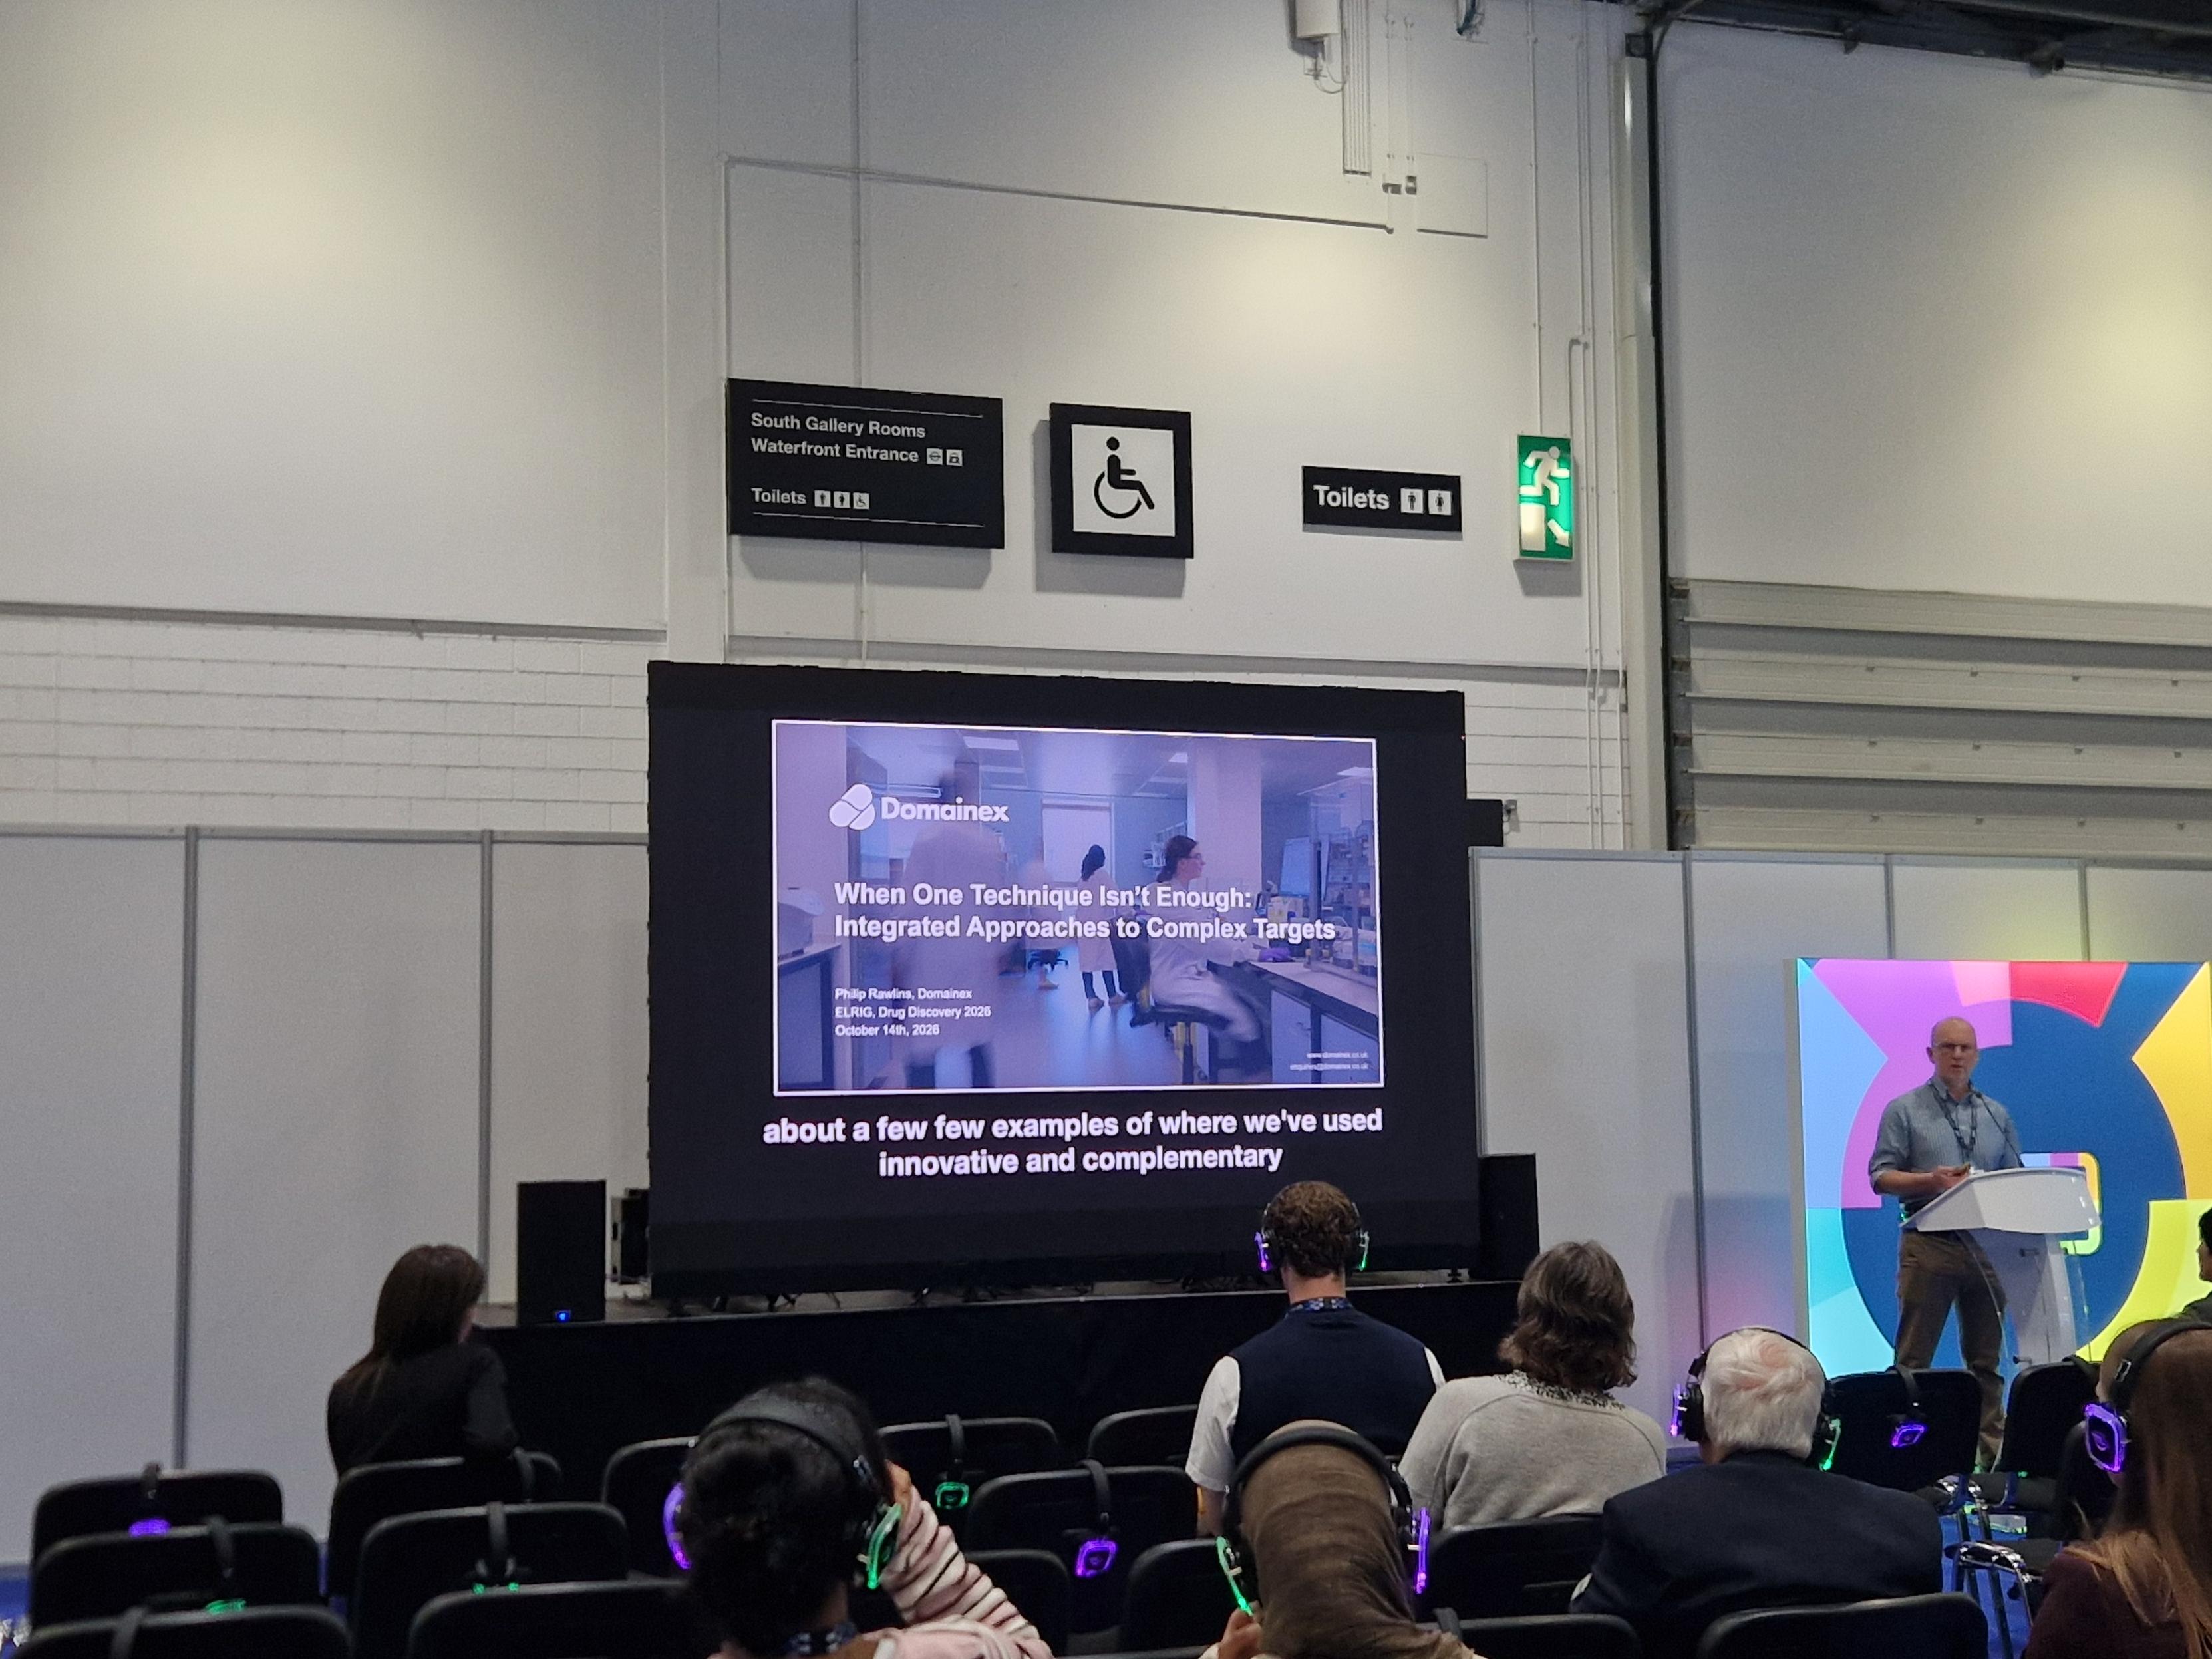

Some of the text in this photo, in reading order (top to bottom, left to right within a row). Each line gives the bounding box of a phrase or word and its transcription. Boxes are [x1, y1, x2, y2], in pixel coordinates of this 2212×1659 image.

[751, 412, 925, 438] South Gallery Rooms
[751, 437, 919, 462] Waterfront Entrance
[751, 488, 806, 504] Toilets
[1313, 484, 1390, 510] Toilets
[880, 796, 1010, 822] Domainex
[834, 882, 905, 905] When
[913, 883, 963, 905] One
[969, 883, 1093, 911] Technique
[1156, 886, 1251, 913] Enough:
[835, 915, 1336, 944] Integrated Approaches to Complex Targets
[834, 988, 866, 1002] Philip
[917, 988, 973, 1000] Domainex
[834, 1006, 876, 1019] ELRIG,
[878, 1006, 906, 1020] Drug
[907, 1006, 962, 1020] Discovery
[834, 1024, 880, 1037] October
[883, 1024, 909, 1037] 14th,
[763, 1117, 846, 1144] about
[852, 1122, 870, 1142] a
[876, 1115, 929, 1141] few
[933, 1114, 985, 1139] few
[991, 1112, 1119, 1142] examples
[1126, 1110, 1153, 1135] of
[1158, 1110, 1237, 1135] where
[1323, 1108, 1383, 1132] used
[879, 1145, 1283, 1177] innovative and complementary
